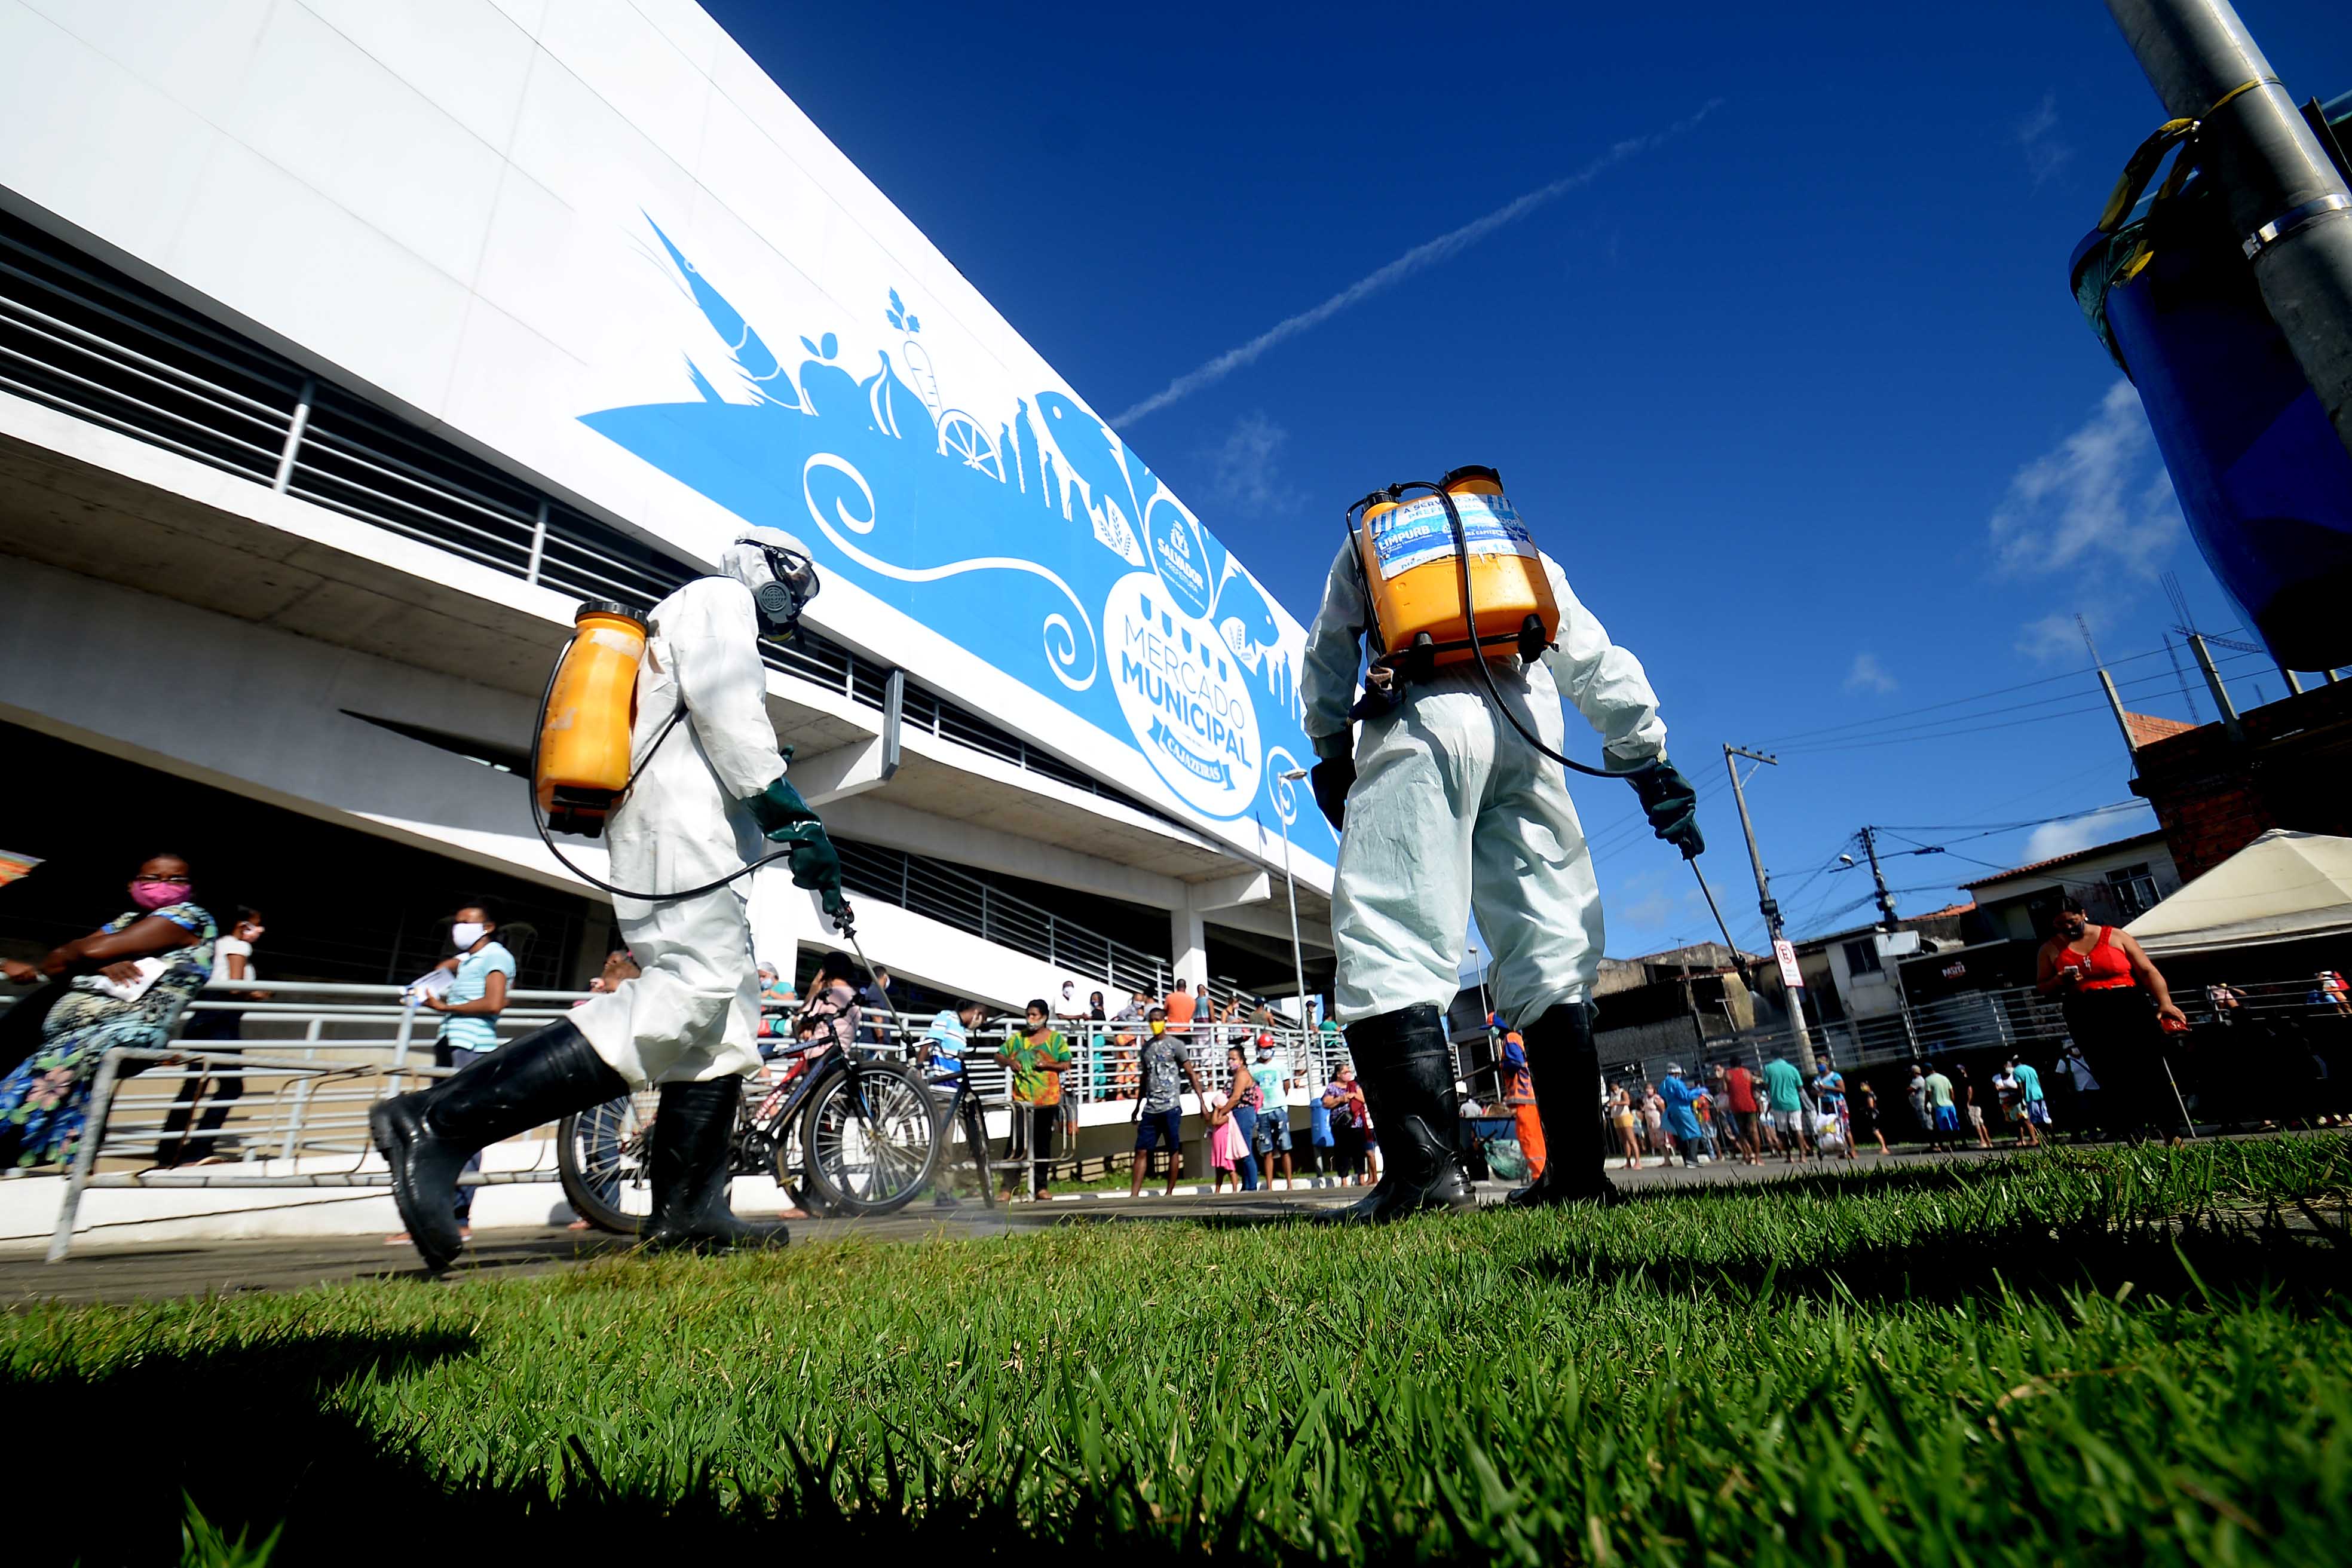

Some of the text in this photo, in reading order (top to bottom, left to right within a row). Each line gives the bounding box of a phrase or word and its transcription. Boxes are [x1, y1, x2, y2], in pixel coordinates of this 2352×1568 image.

[1157, 537, 1204, 590] SALVADOR
[1378, 525, 1431, 550] LIMPURB
[1125, 614, 1245, 729] MERCADO
[1121, 650, 1252, 770] MUNICIPAL
[1166, 737, 1220, 780] CAJAZEIRAS
